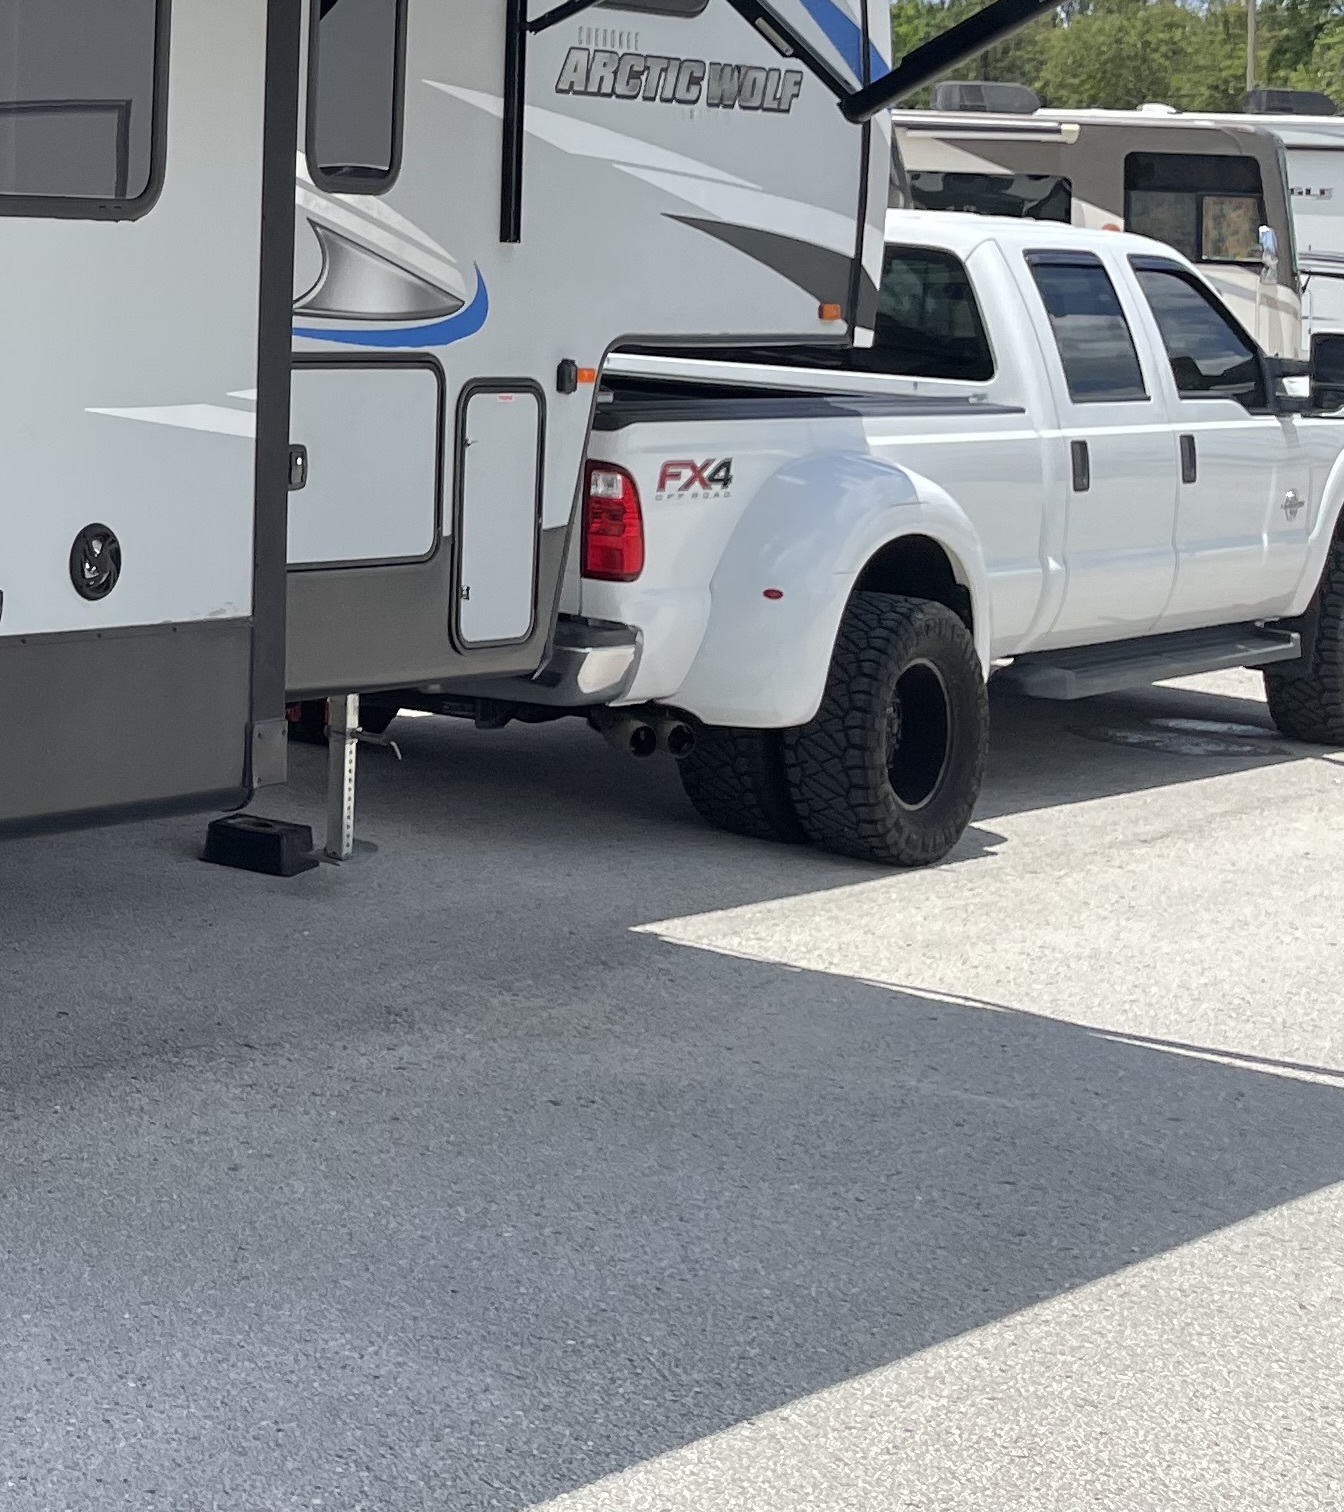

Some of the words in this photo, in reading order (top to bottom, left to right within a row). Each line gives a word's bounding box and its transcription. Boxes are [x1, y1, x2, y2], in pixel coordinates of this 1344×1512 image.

[577, 26, 640, 51] CHEROKEE
[555, 47, 705, 105] ARCTIC
[705, 62, 803, 114] WOLF
[656, 457, 733, 493] FX4
[692, 491, 731, 499] ROAD
